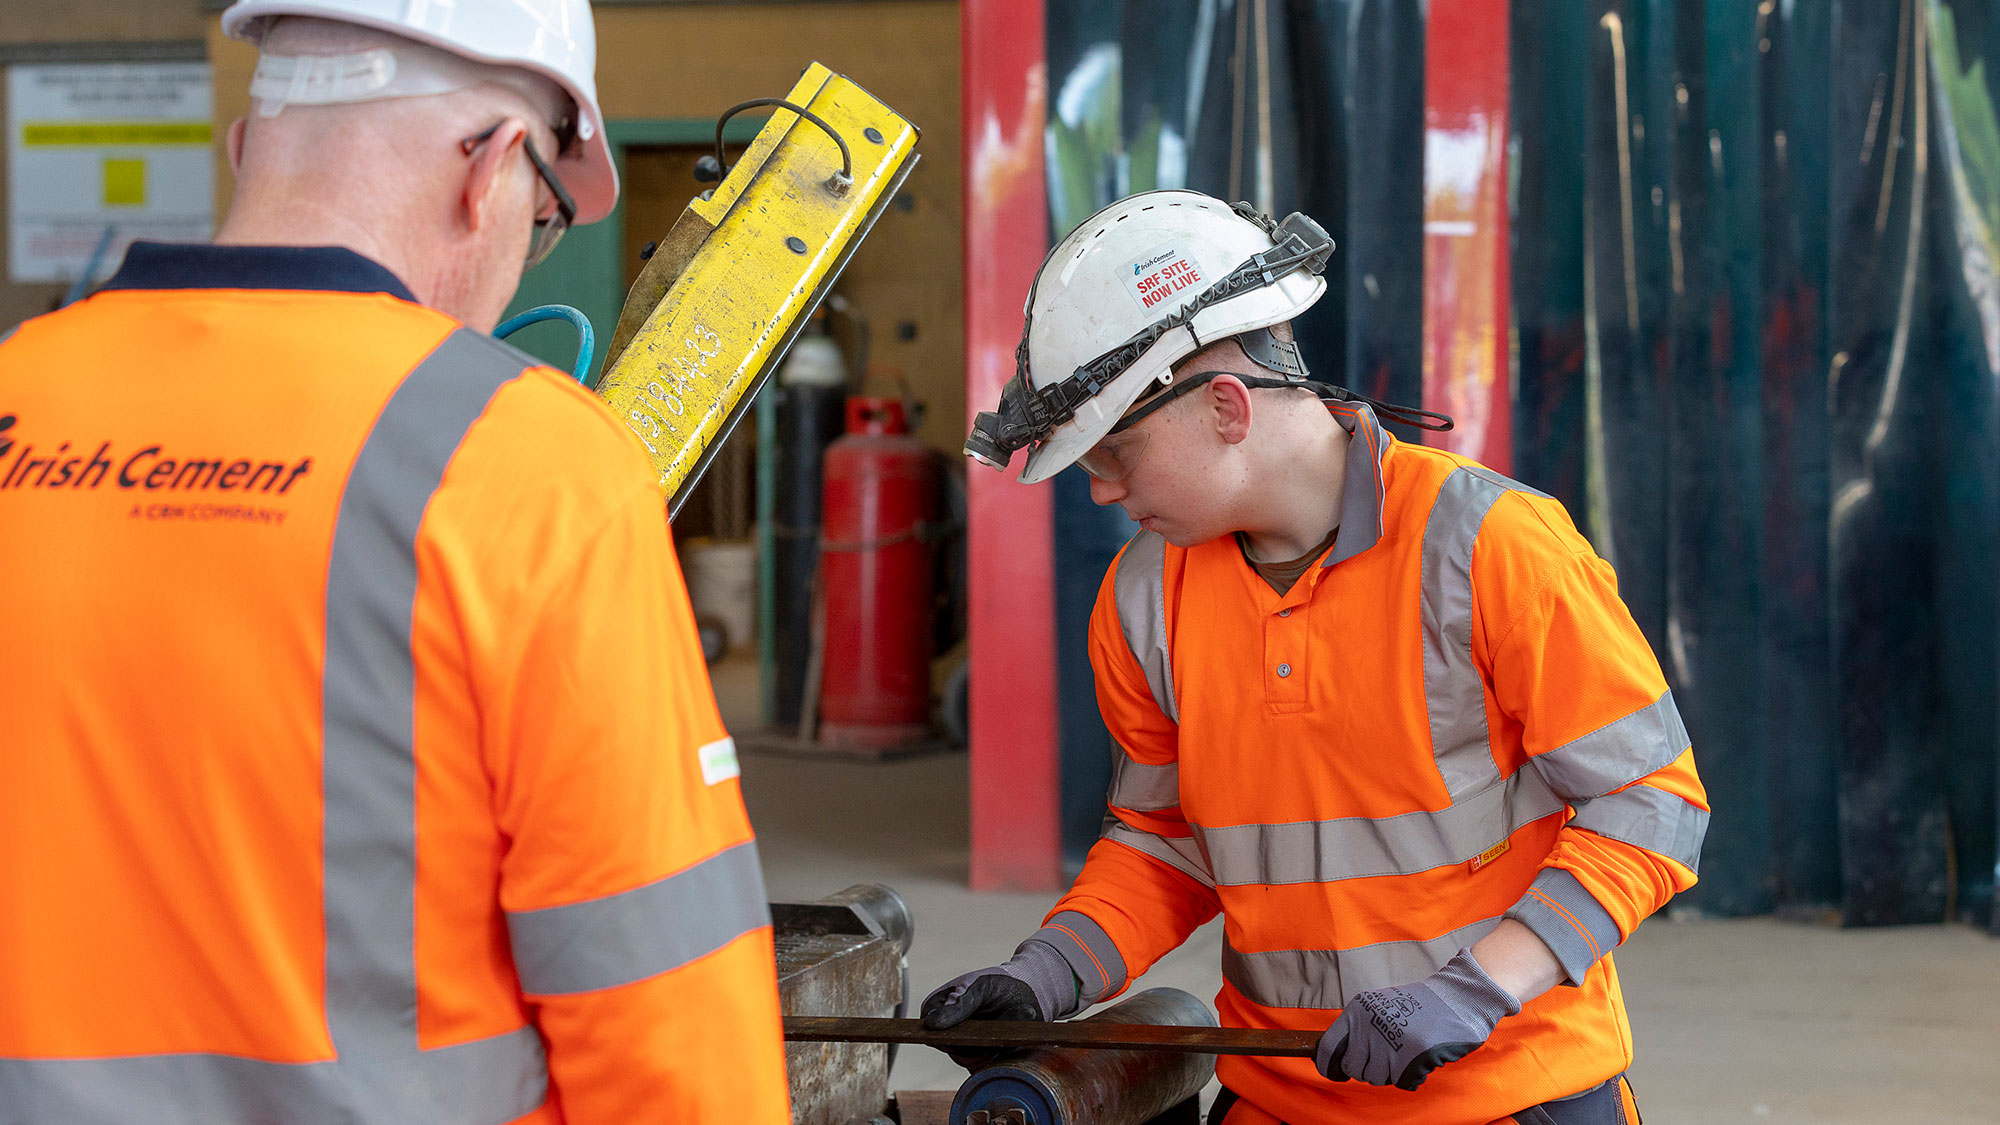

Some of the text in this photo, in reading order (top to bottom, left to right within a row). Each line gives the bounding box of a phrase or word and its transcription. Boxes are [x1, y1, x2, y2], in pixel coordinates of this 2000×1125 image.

[1137, 273, 1160, 293] SRF
[1161, 259, 1191, 280] SITE
[1140, 259, 1154, 270] Irish
[1153, 249, 1174, 263] Cement
[1142, 270, 1201, 308] NOW LIVE
[1, 441, 314, 494] Irish Cement
